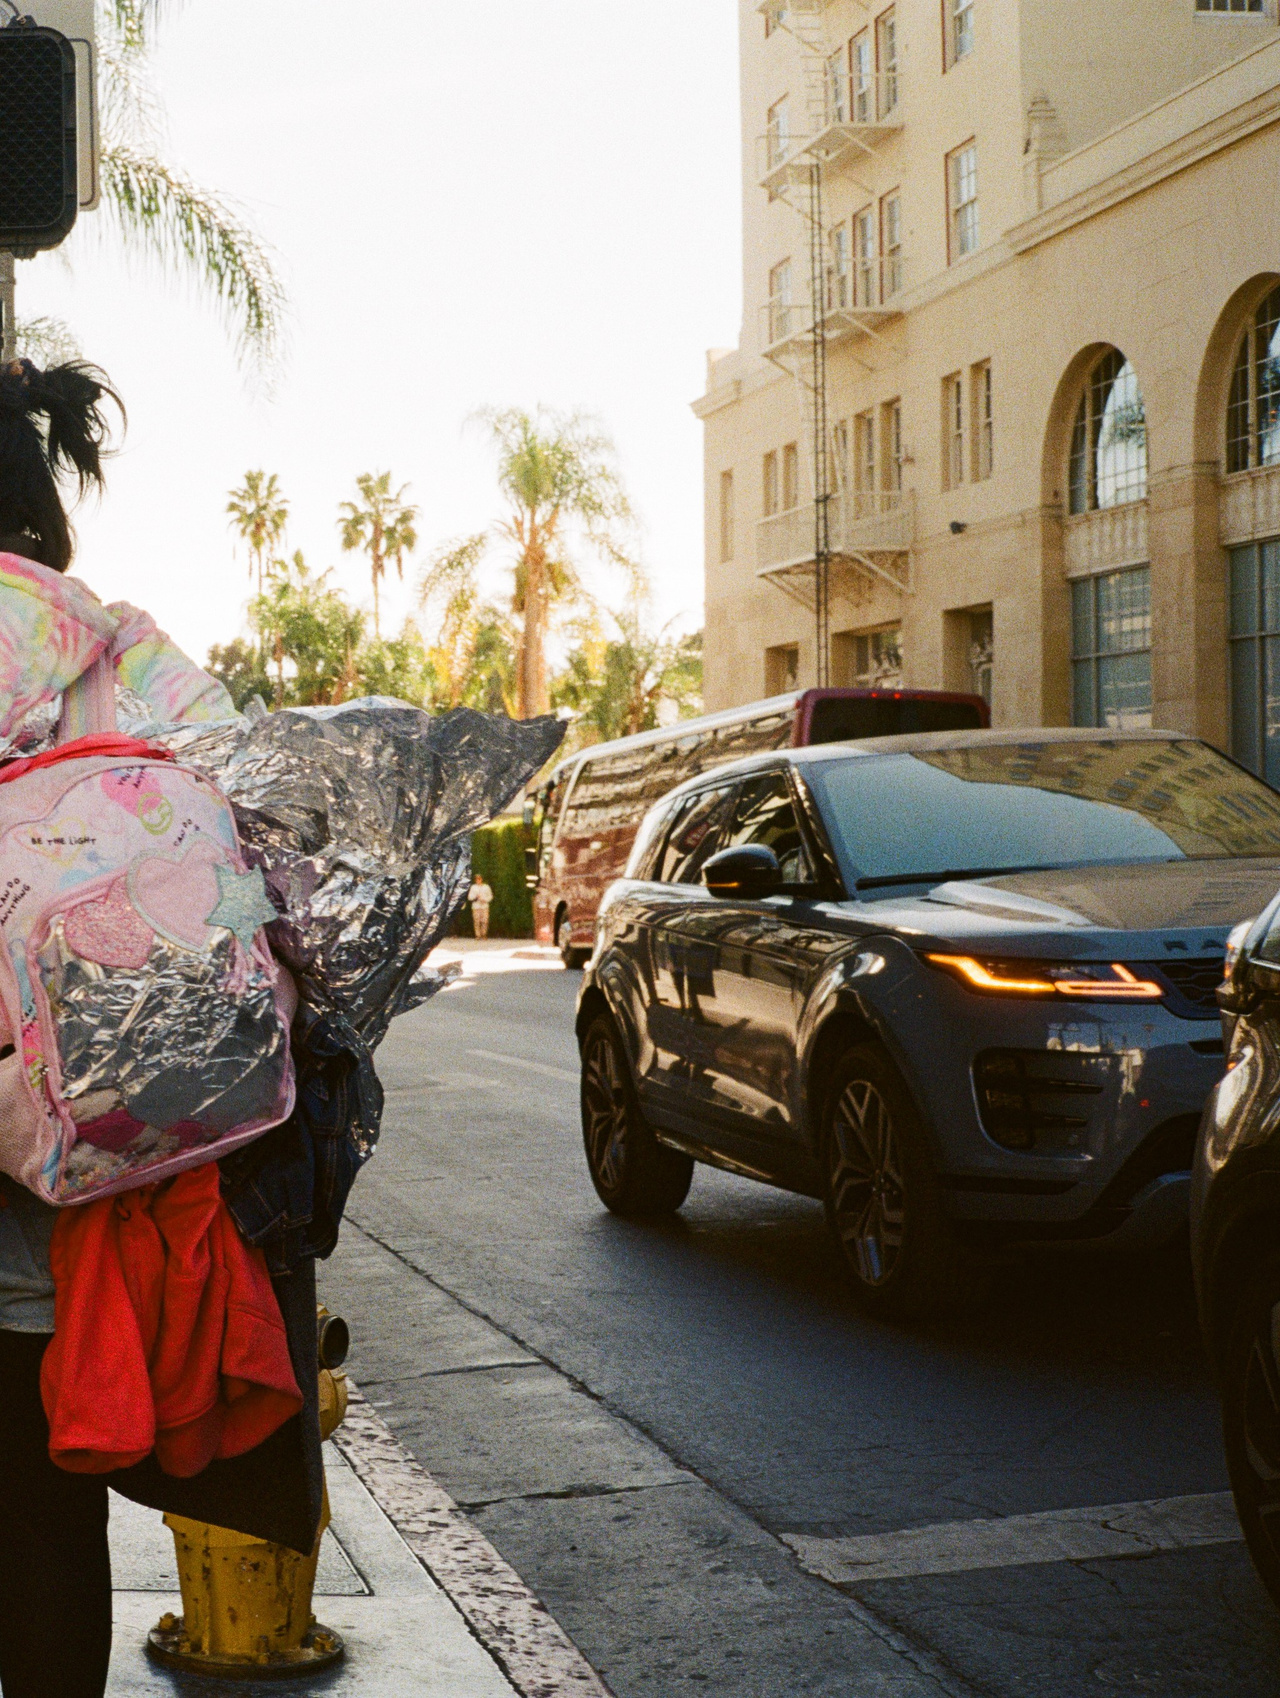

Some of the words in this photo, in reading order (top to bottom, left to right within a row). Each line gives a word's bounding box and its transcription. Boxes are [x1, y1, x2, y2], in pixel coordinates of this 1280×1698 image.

[30, 837, 43, 846] BE
[46, 837, 66, 846] THE
[6, 877, 21, 889] DO
